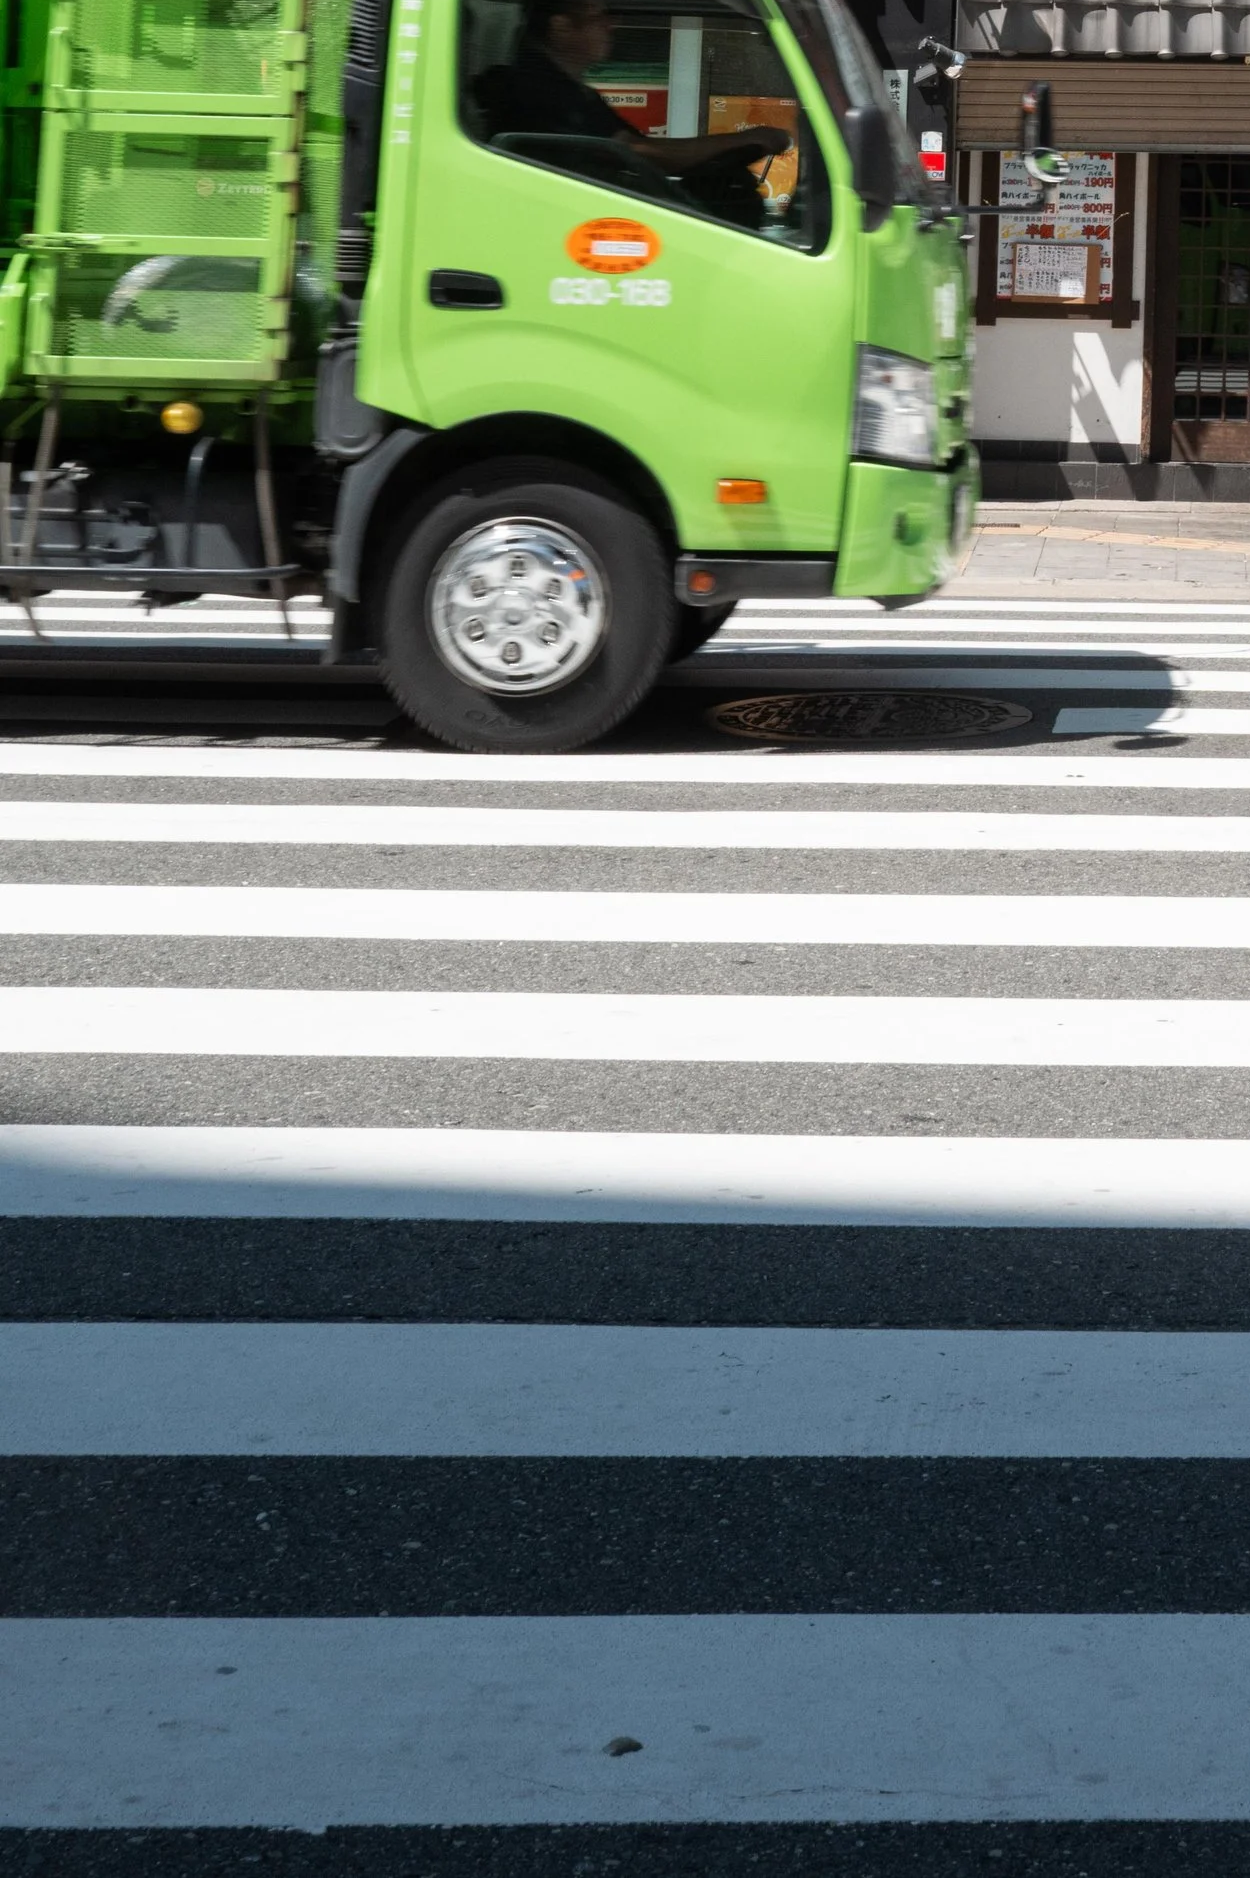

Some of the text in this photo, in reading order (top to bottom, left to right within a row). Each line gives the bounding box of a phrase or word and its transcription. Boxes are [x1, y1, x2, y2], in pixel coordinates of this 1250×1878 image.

[1068, 162, 1108, 170] ラックニッカ
